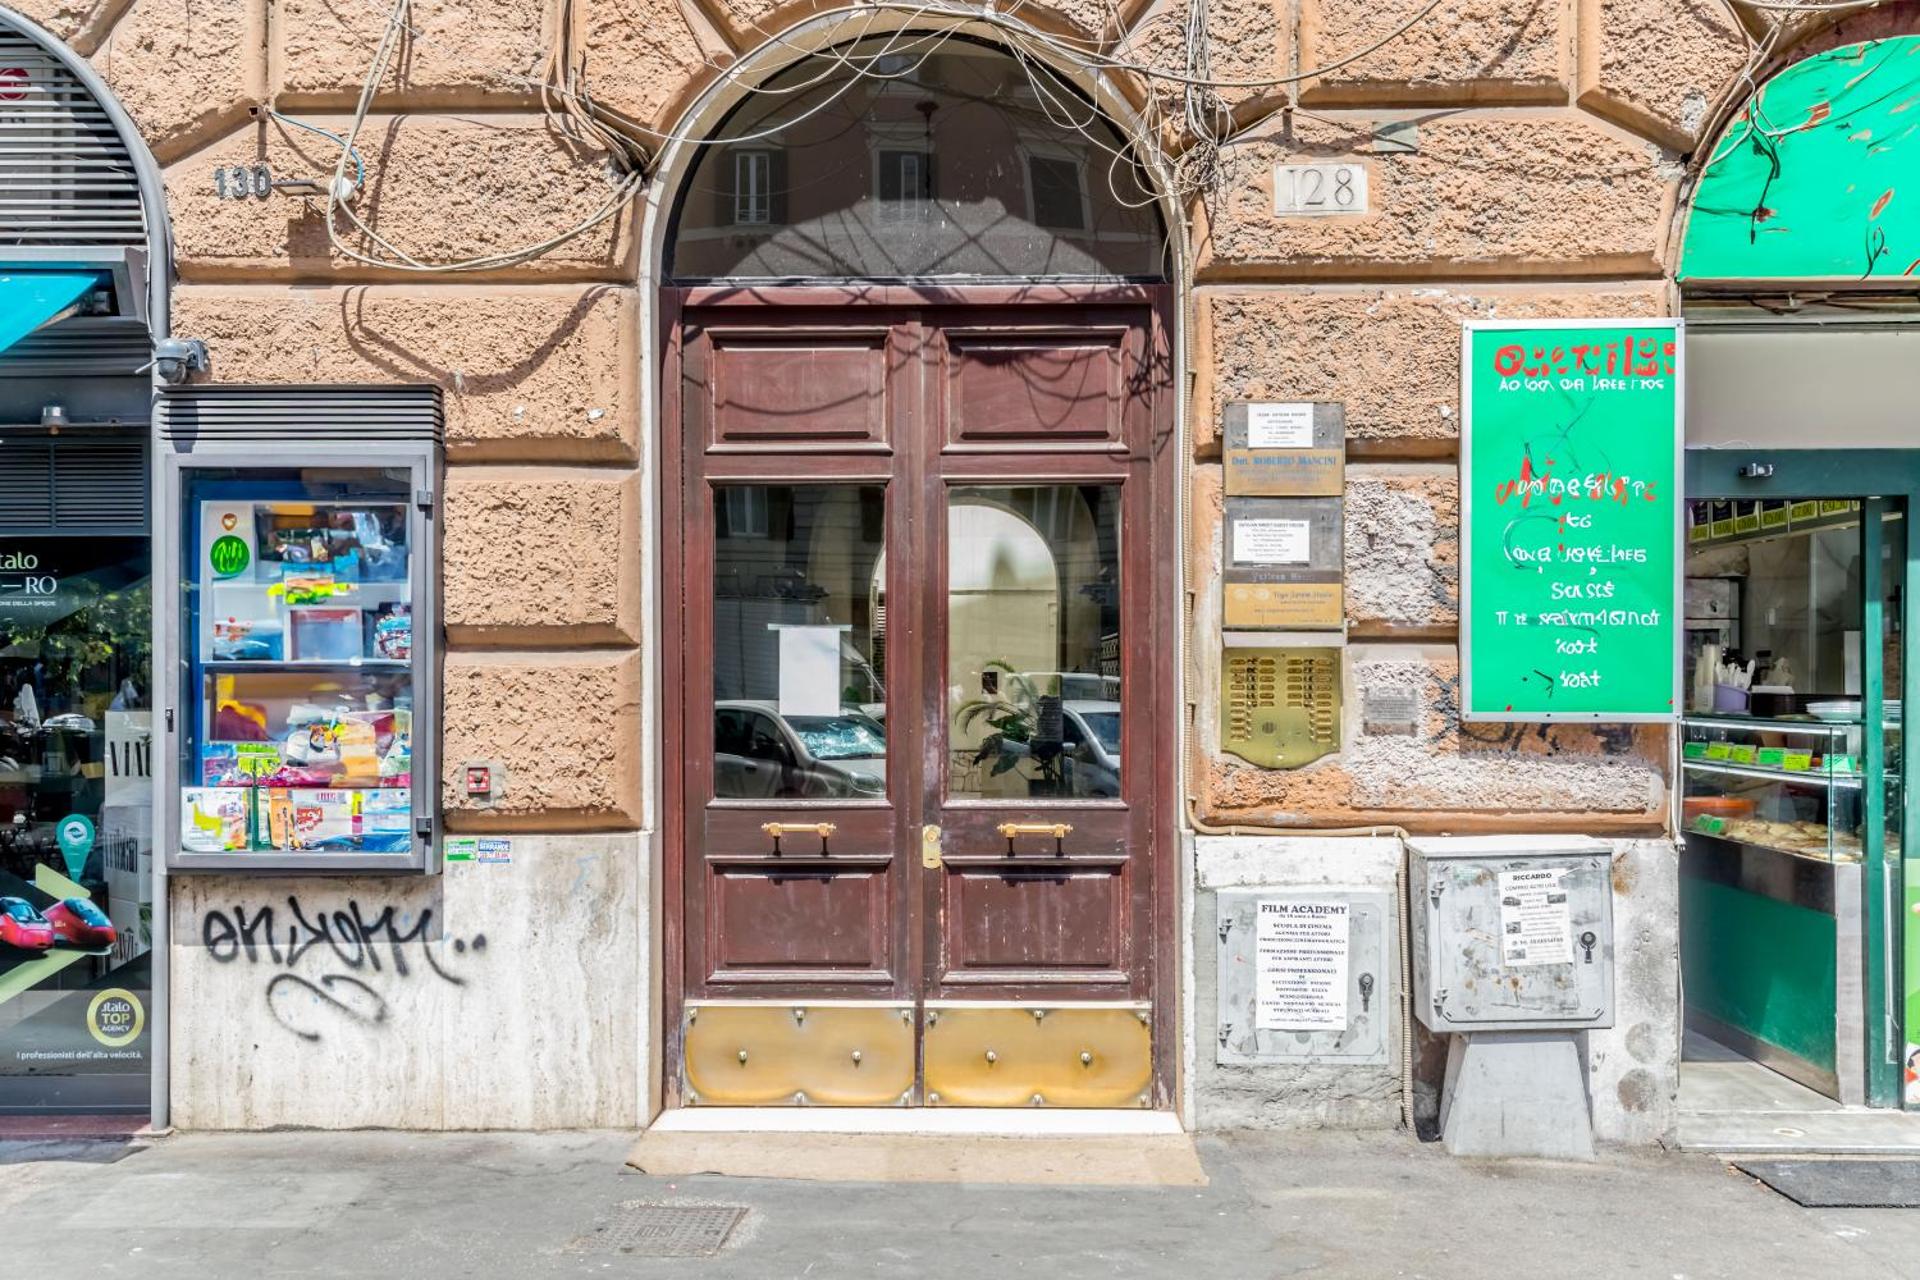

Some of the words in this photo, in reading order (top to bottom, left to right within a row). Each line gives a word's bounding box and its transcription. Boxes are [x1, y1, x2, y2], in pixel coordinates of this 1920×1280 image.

[213, 165, 272, 200] 130
[1286, 168, 1355, 207] 128
[1512, 873, 1552, 881] RICCARDO
[1261, 904, 1289, 913] FILM
[1290, 904, 1348, 915] ACADEMY
[101, 1013, 130, 1024] TOP
[21, 1051, 75, 1060] professionisti
